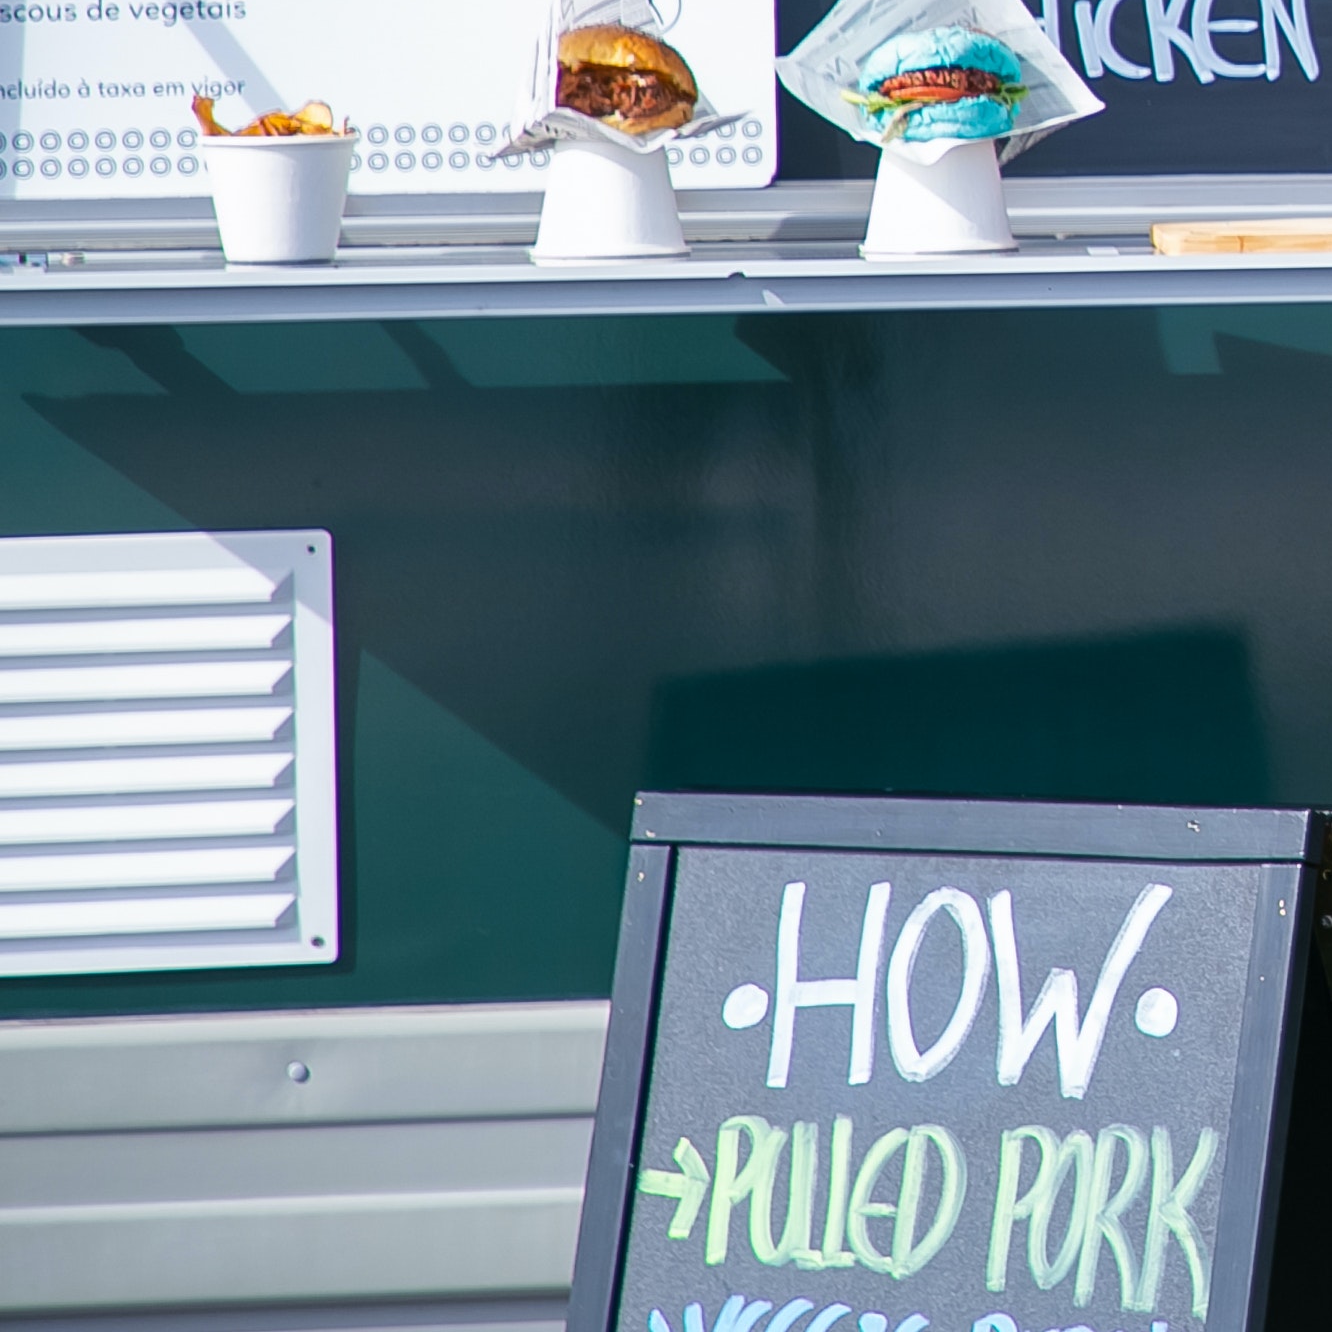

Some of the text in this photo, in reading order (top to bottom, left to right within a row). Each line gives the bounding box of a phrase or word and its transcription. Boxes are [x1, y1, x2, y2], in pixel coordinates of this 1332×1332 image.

[98, 80, 146, 98] taxa
[152, 81, 184, 96] em
[191, 75, 246, 100] vigor
[705, 1115, 1218, 1320] PULLED PORK
